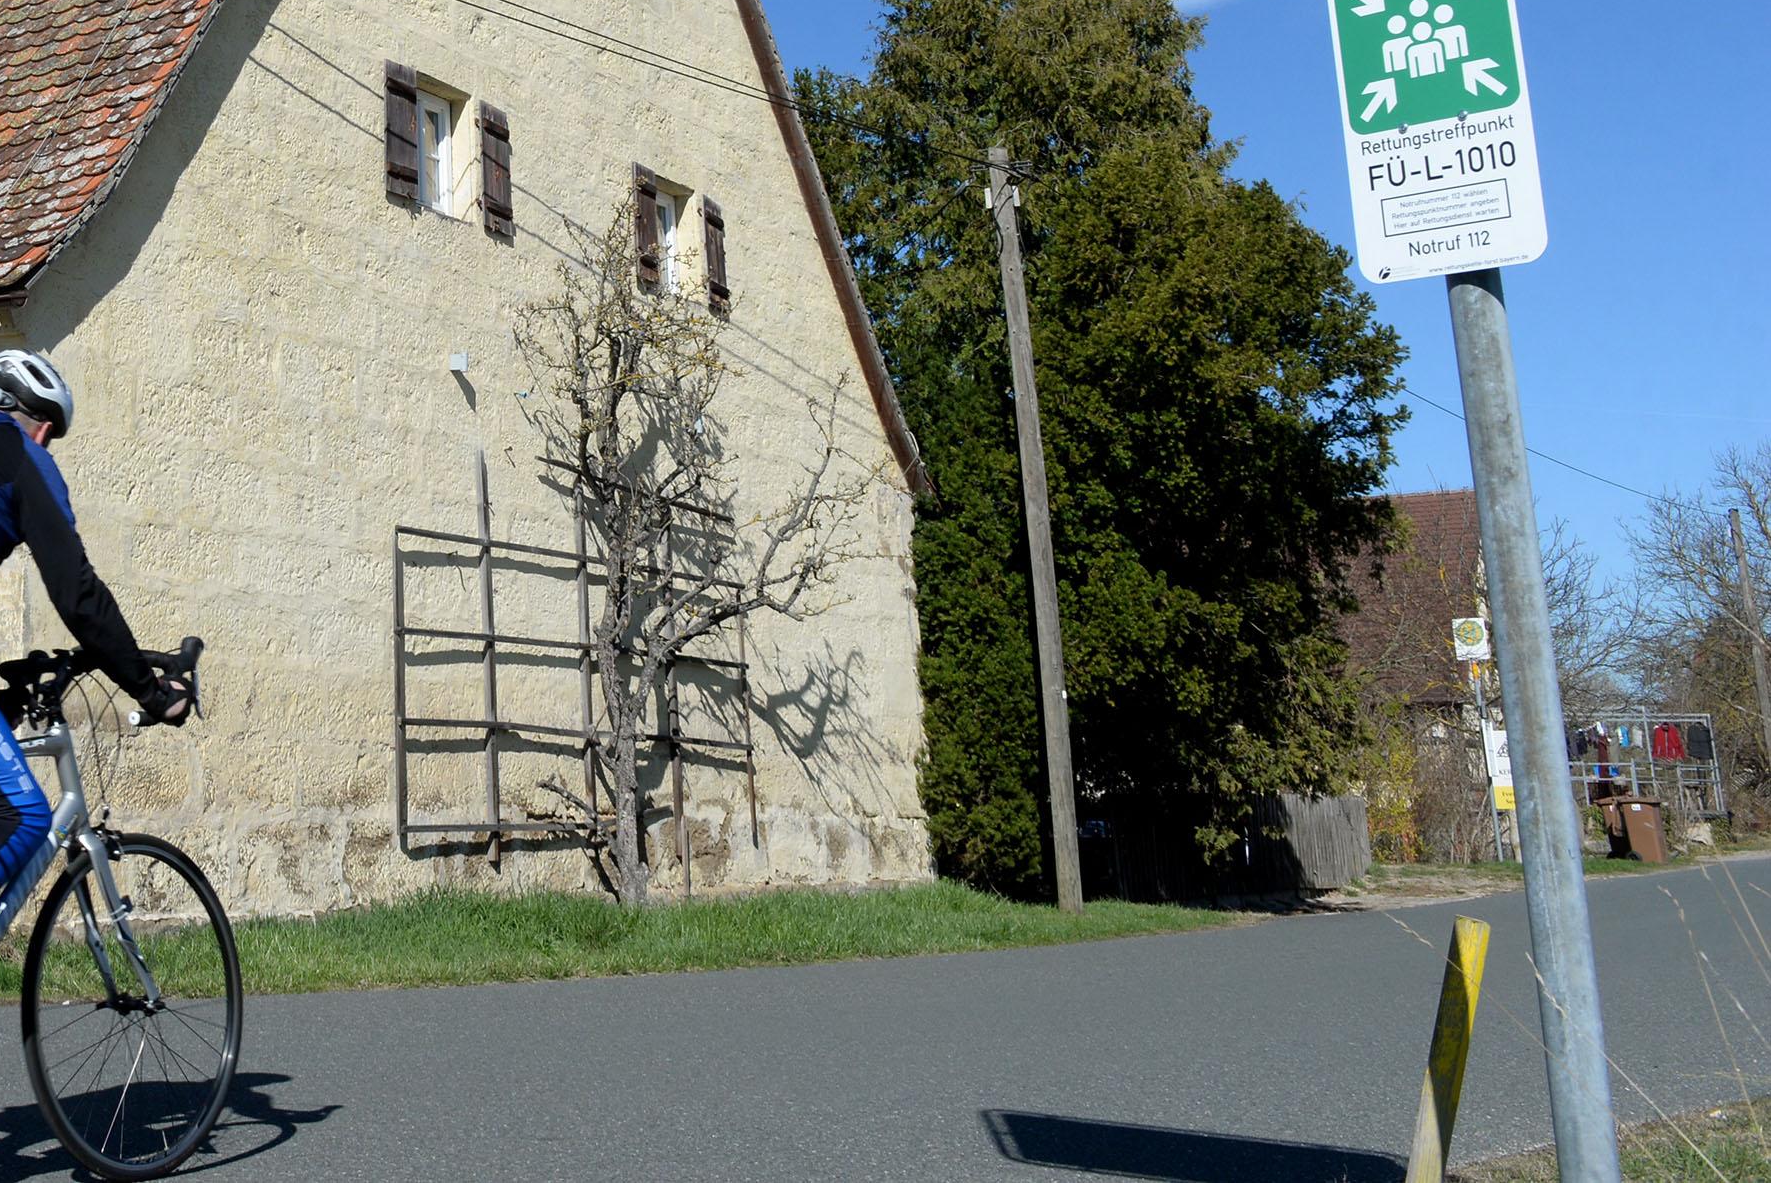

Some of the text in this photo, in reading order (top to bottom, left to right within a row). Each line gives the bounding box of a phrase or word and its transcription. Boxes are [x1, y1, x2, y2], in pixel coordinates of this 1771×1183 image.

[1360, 114, 1515, 156] Rettungstreffpunkt
[1368, 140, 1517, 192] FÜ-L-1010
[1408, 230, 1491, 257] Notruf 112
